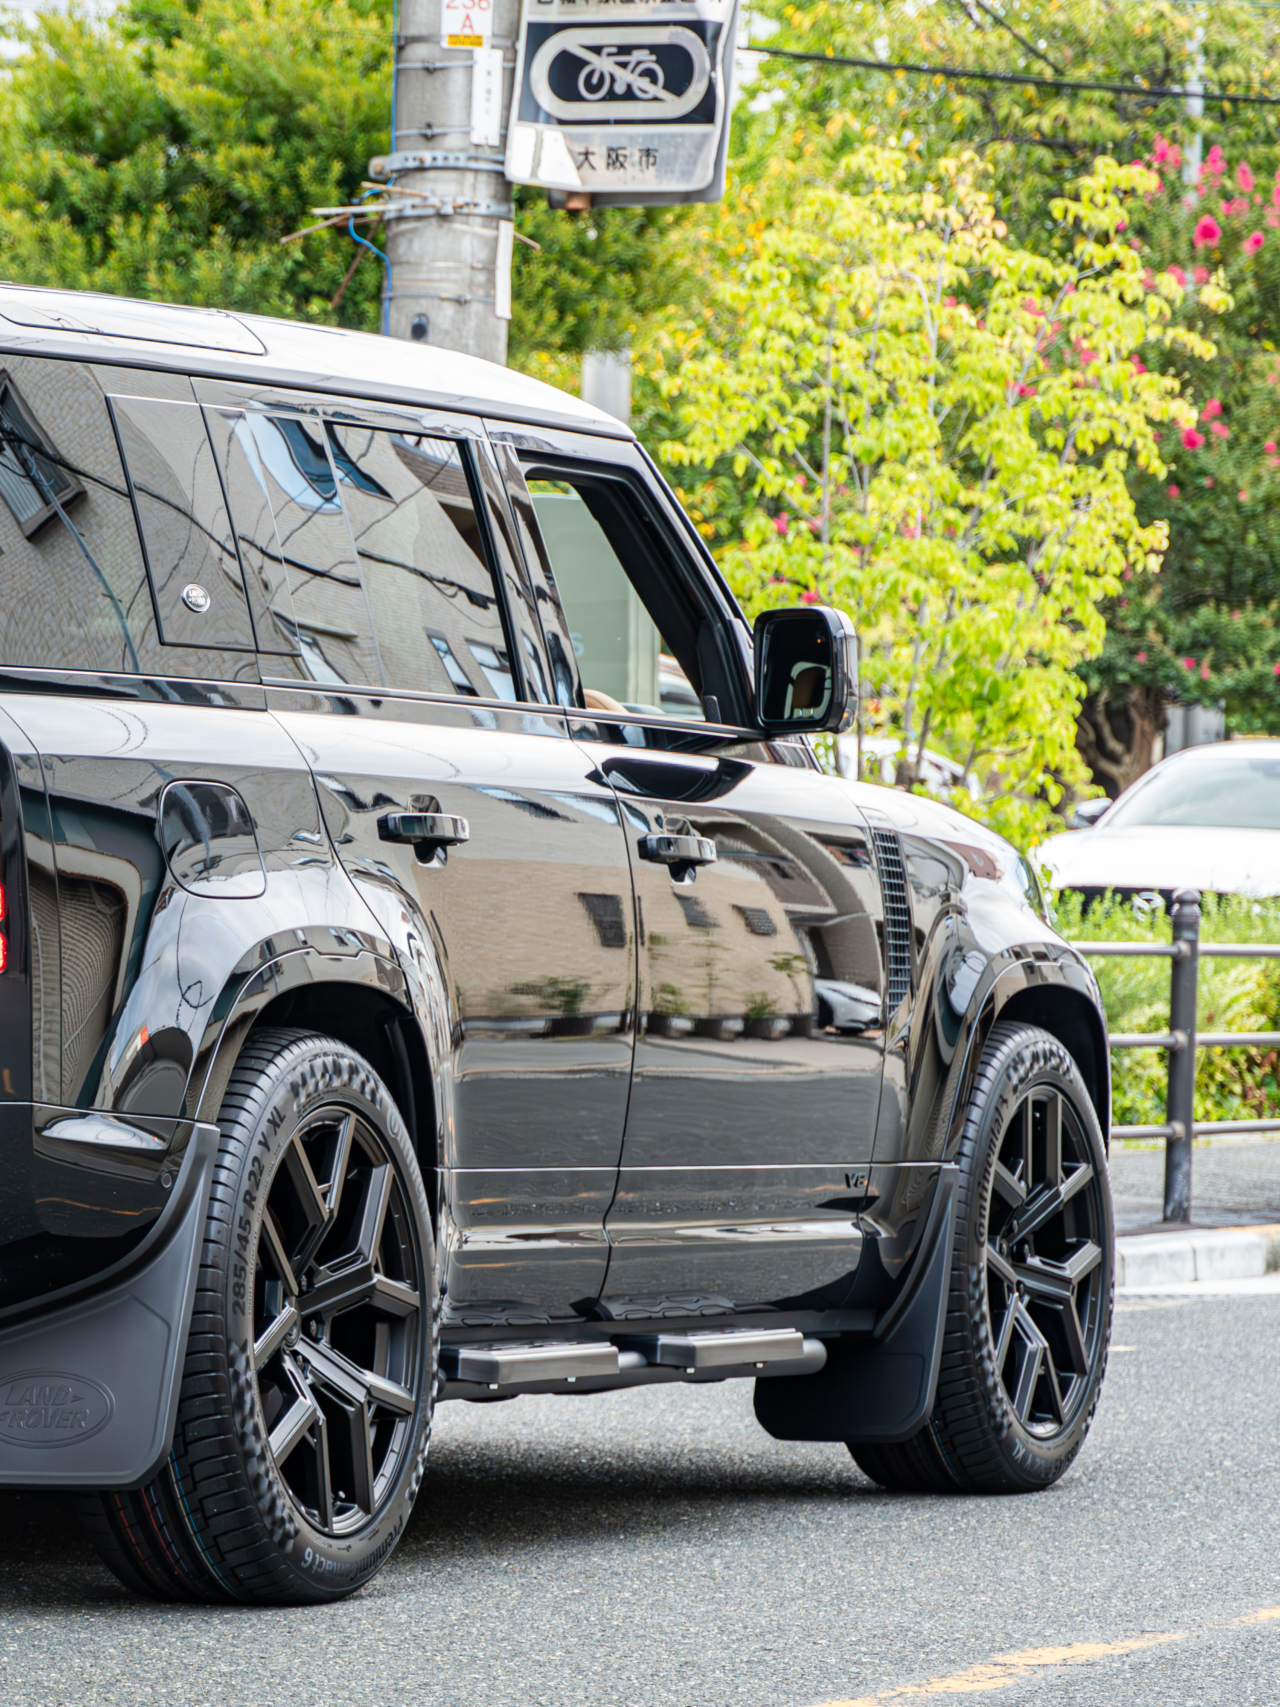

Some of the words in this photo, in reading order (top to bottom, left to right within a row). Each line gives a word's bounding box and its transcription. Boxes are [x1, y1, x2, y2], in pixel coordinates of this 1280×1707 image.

[460, 13, 475, 35] A
[577, 146, 659, 171] 大阪市
[231, 1215, 252, 1317] 285/45
[257, 1130, 271, 1153] Y
[266, 1105, 286, 1137] XL
[4, 1383, 73, 1406] LAND
[7, 1408, 90, 1430] ROVER
